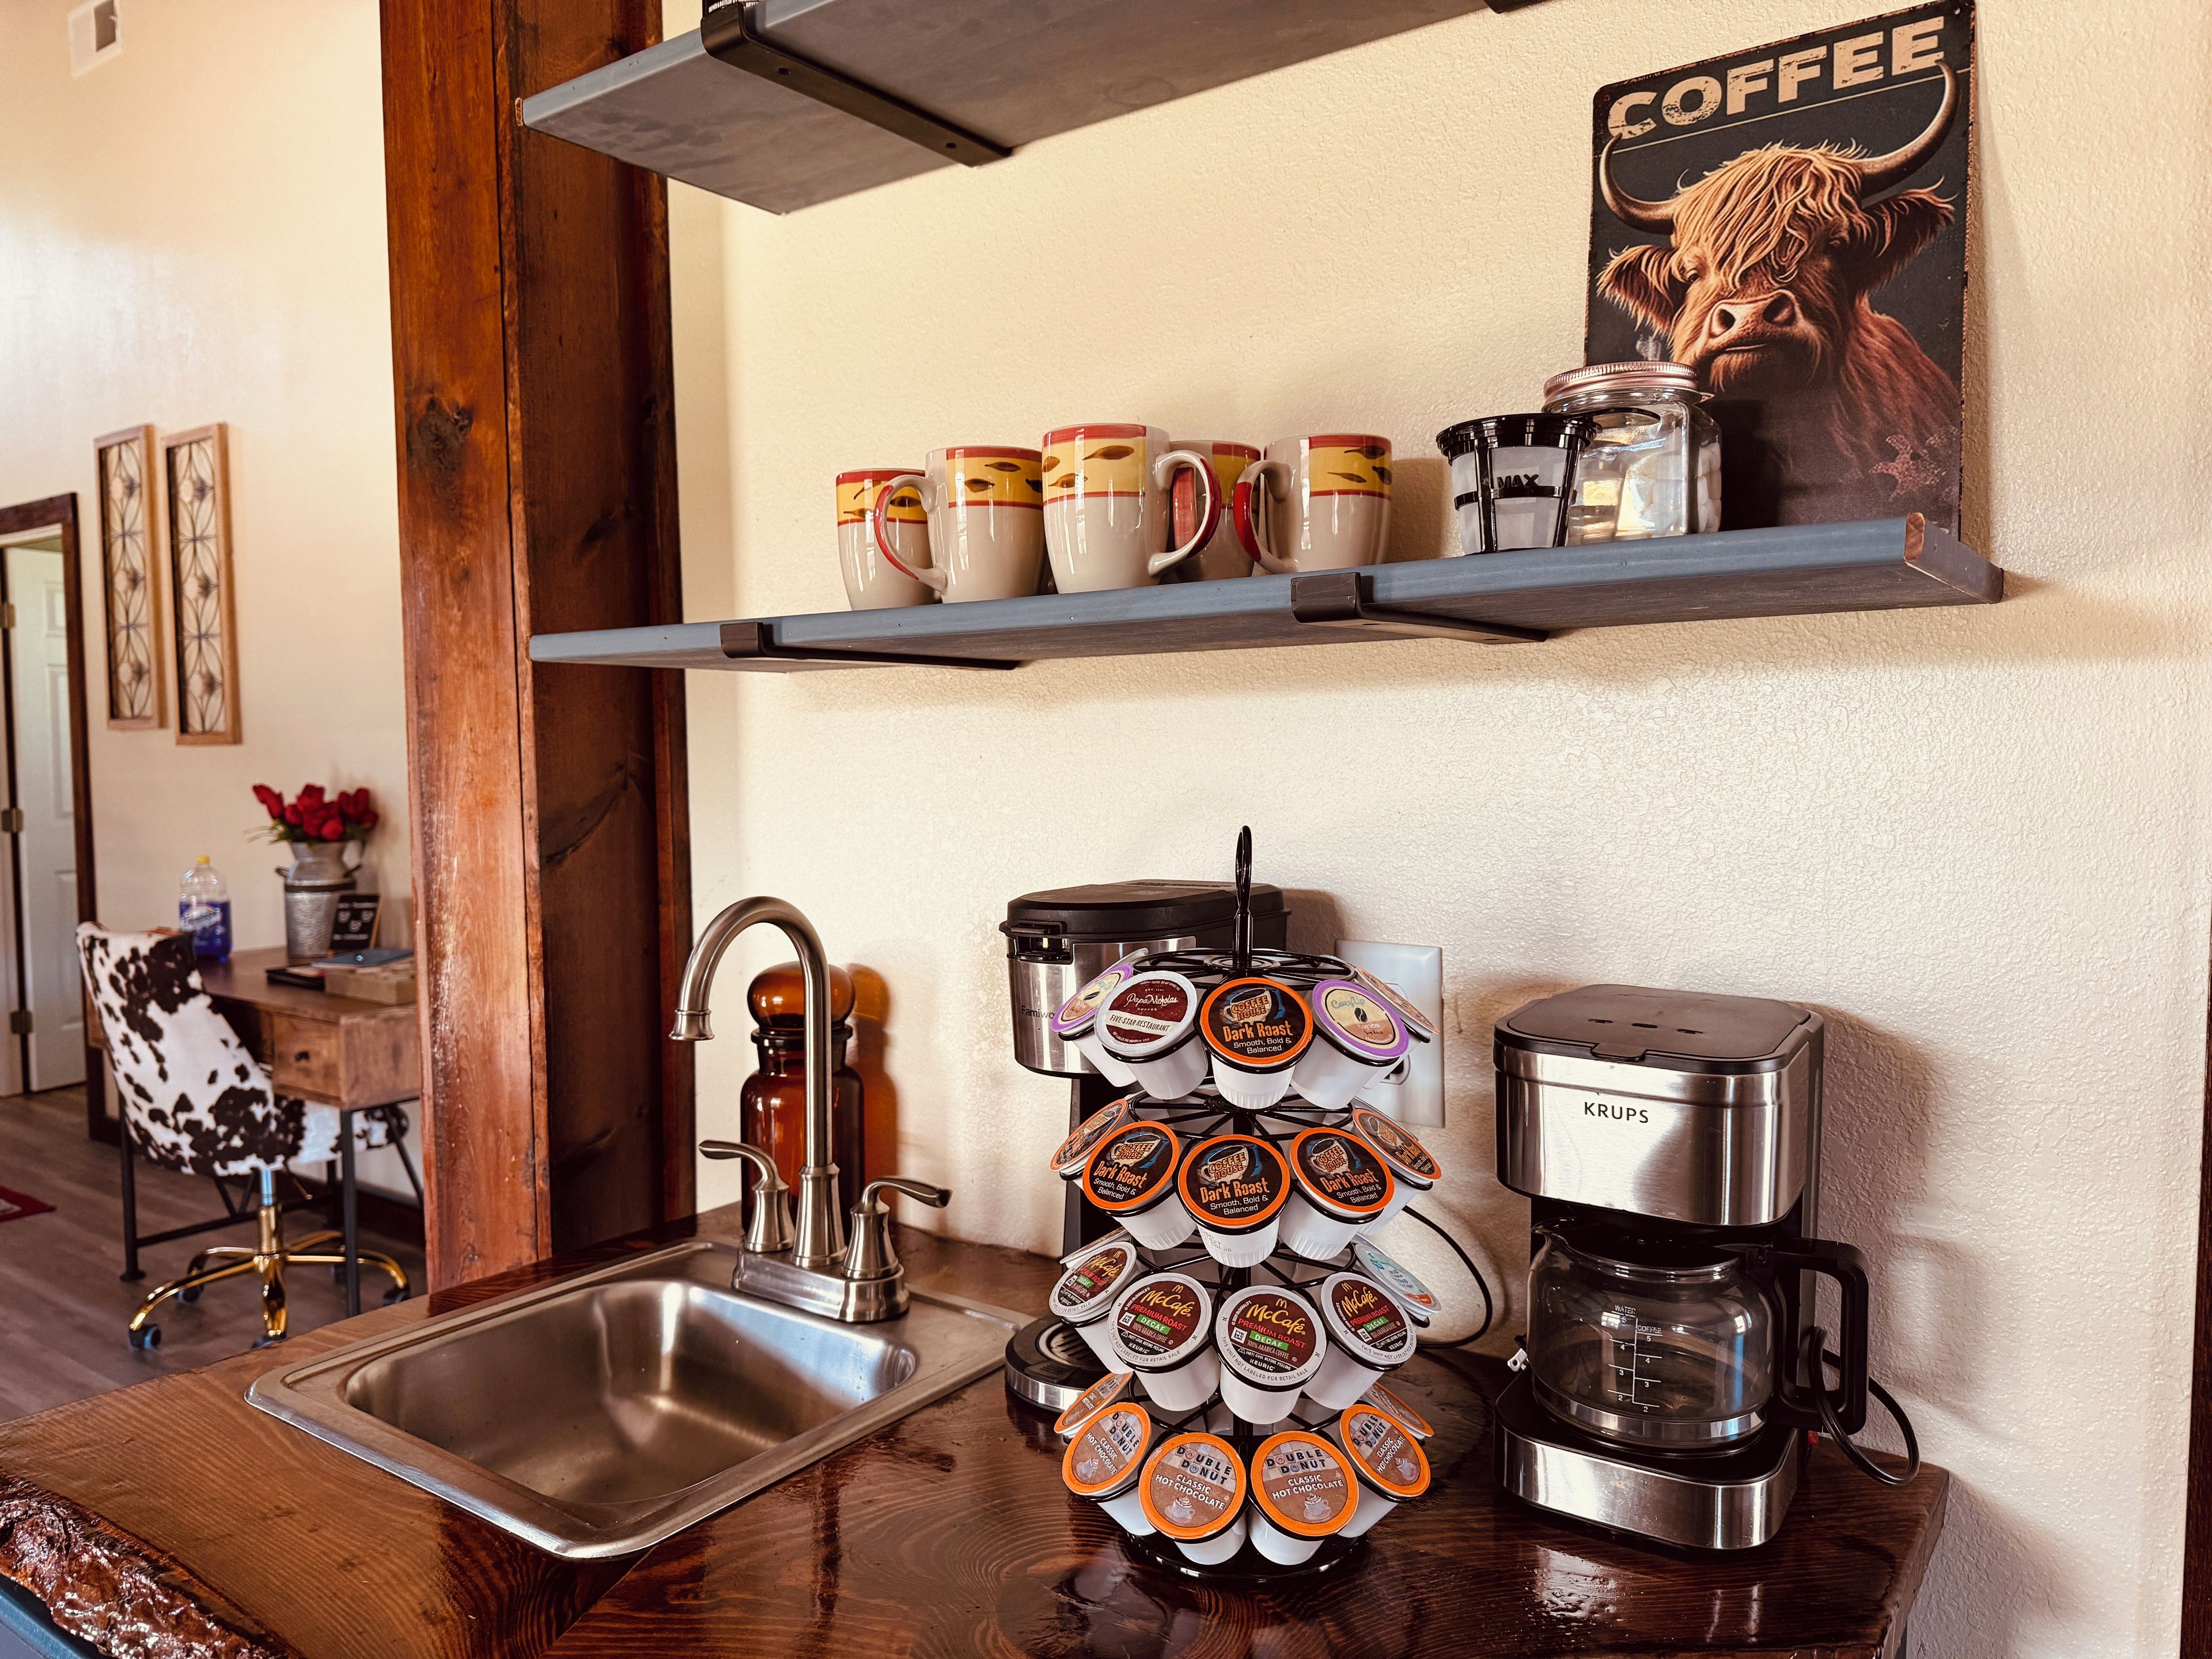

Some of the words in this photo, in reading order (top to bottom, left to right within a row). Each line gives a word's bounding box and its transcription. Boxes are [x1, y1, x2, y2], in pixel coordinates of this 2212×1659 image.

[1608, 16, 1945, 140] COFFEE
[1497, 474, 1539, 488] MAX
[1123, 993, 1149, 1007] Papa
[1145, 995, 1177, 1006] Nicholas
[1231, 995, 1268, 1014] COFFEE
[1110, 1014, 1137, 1027] FIVE-STAR
[1136, 1020, 1171, 1032] RESTAURANT
[1237, 1006, 1266, 1021] HOUSE
[1222, 1024, 1254, 1041] Dark
[1256, 1021, 1293, 1037] Roast
[1234, 1039, 1265, 1048] Smooth,
[1247, 1045, 1282, 1054] Balanced
[1584, 1101, 1649, 1123] KRUPS
[1119, 1143, 1153, 1152] COFFEE
[1316, 1146, 1344, 1165] COFFEE
[1209, 1152, 1246, 1173] COFFEE
[1214, 1163, 1243, 1180] HOUSE
[1324, 1156, 1347, 1172] HOUSE
[1094, 1161, 1118, 1179] Dark
[1116, 1166, 1147, 1188] Roast
[1320, 1176, 1350, 1193] Dark
[1346, 1169, 1379, 1187] Roast
[1094, 1178, 1115, 1189] Smooth,
[1117, 1184, 1130, 1193] Bold
[1098, 1187, 1124, 1199] Balanced
[1200, 1183, 1230, 1203] Dark
[1233, 1177, 1270, 1197] Roast
[1336, 1190, 1363, 1198] Smooth,
[1210, 1200, 1241, 1210] Smooth,
[1244, 1196, 1260, 1204] Bold
[1350, 1192, 1378, 1203] Balanced
[1224, 1205, 1258, 1215] Balanced
[1088, 1256, 1123, 1277] McCafé
[1092, 1275, 1106, 1286] ROAST
[1140, 1290, 1195, 1317] McCafé
[1341, 1286, 1375, 1317] McCafé
[1615, 1305, 1636, 1314] WATER
[1131, 1304, 1164, 1321] PREMIUM
[1163, 1316, 1188, 1331] ROAST
[1141, 1318, 1165, 1331] DECAF
[1246, 1304, 1305, 1335] McCafé
[1350, 1314, 1374, 1326] PREMIUM
[1372, 1305, 1390, 1318] ROAST
[1367, 1319, 1385, 1330] DECAF
[1132, 1323, 1142, 1332] 100%
[1141, 1326, 1156, 1338] ARABICA
[1155, 1332, 1168, 1343] COFFEE
[1238, 1318, 1276, 1338] PREMIUM
[1278, 1334, 1306, 1349] ROAST
[1637, 1325, 1661, 1334] COFFEE
[1128, 1343, 1150, 1353] KEURIG
[1153, 1344, 1165, 1353] PEELING
[1247, 1340, 1257, 1349] 100%
[1257, 1344, 1275, 1354] ARABICA
[1275, 1350, 1289, 1359] COFFEE
[1255, 1334, 1283, 1347] DECAF
[1362, 1345, 1372, 1353] THIS
[1120, 1349, 1138, 1360] LABELED
[1235, 1358, 1243, 1368] NOT
[1244, 1367, 1266, 1379] LABELED
[1297, 1368, 1308, 1377] SALE
[1249, 1359, 1275, 1371] KEURIG
[1277, 1361, 1291, 1370] PEELING
[1112, 1412, 1139, 1447] DOUBLE
[1353, 1415, 1378, 1446] DOUBLE
[1366, 1422, 1386, 1448] DONUT
[1100, 1438, 1118, 1460] CLASSIC
[1109, 1426, 1132, 1455] DONUT
[1377, 1437, 1393, 1457] CLASSIC
[1086, 1432, 1098, 1445] HOT
[1095, 1445, 1118, 1474] CHOCOLATE
[1177, 1446, 1232, 1475] DOUBLE
[1266, 1449, 1323, 1467] DOUBLE
[1377, 1459, 1386, 1474] HOT
[1383, 1435, 1405, 1464] CHOCOLATE
[1181, 1460, 1228, 1484] DONUT
[1281, 1459, 1325, 1474] DONUT
[1177, 1474, 1211, 1494] CLASSIC
[1272, 1488, 1291, 1499] HOT
[1293, 1480, 1343, 1494] CHOCOLATE
[1288, 1475, 1322, 1486] CLASSIC
[1156, 1474, 1174, 1487] HOT
[1175, 1482, 1225, 1509] CHOCOLATE
